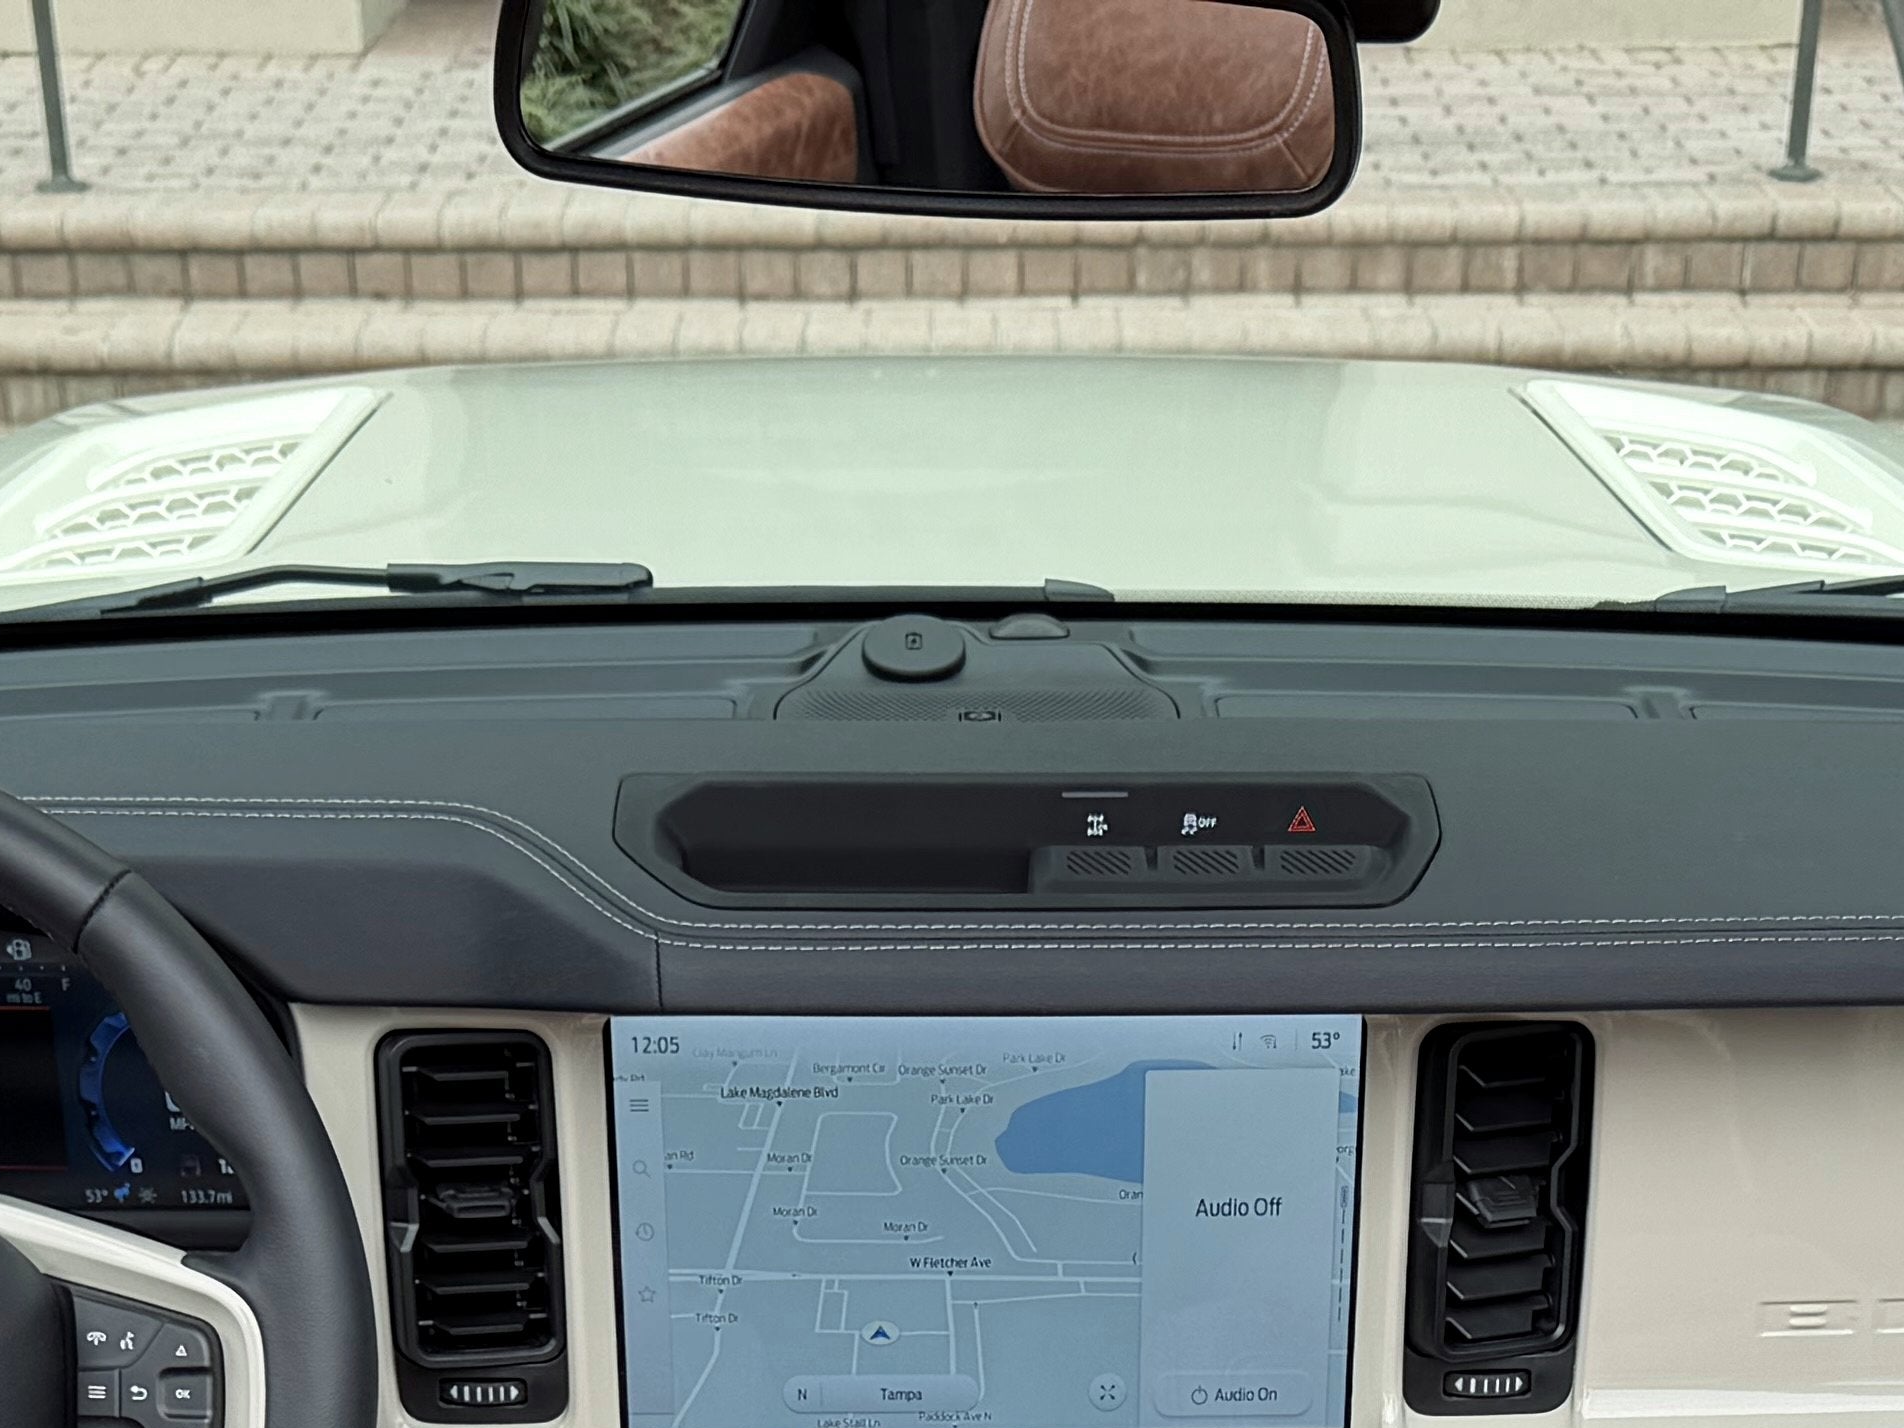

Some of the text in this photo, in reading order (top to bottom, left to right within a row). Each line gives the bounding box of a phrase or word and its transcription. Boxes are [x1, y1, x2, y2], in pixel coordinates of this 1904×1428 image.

[630, 1036, 680, 1054] 12:05
[1311, 1031, 1341, 1050] 53°
[898, 1064, 987, 1079] Orange Sunset Dr
[720, 1086, 839, 1101] Lake Magdalene Blvd
[931, 1094, 994, 1105] Park Lake Dr
[767, 1152, 812, 1163] Moran Dr
[900, 1155, 987, 1168] Orange Sunset Dr
[773, 1206, 818, 1217] Moran Dr
[1195, 1197, 1283, 1217] Audio Off
[884, 1221, 929, 1232] Moran Dr
[909, 1256, 992, 1269] W Fletcher Ave
[699, 1275, 743, 1286] Tifton Dr
[723, 1313, 739, 1324] Dr
[175, 1389, 191, 1399] OK
[797, 1388, 808, 1400] N
[880, 1388, 923, 1402] Tampa
[1214, 1387, 1278, 1402] Audio On
[817, 1418, 840, 1428] Lake
